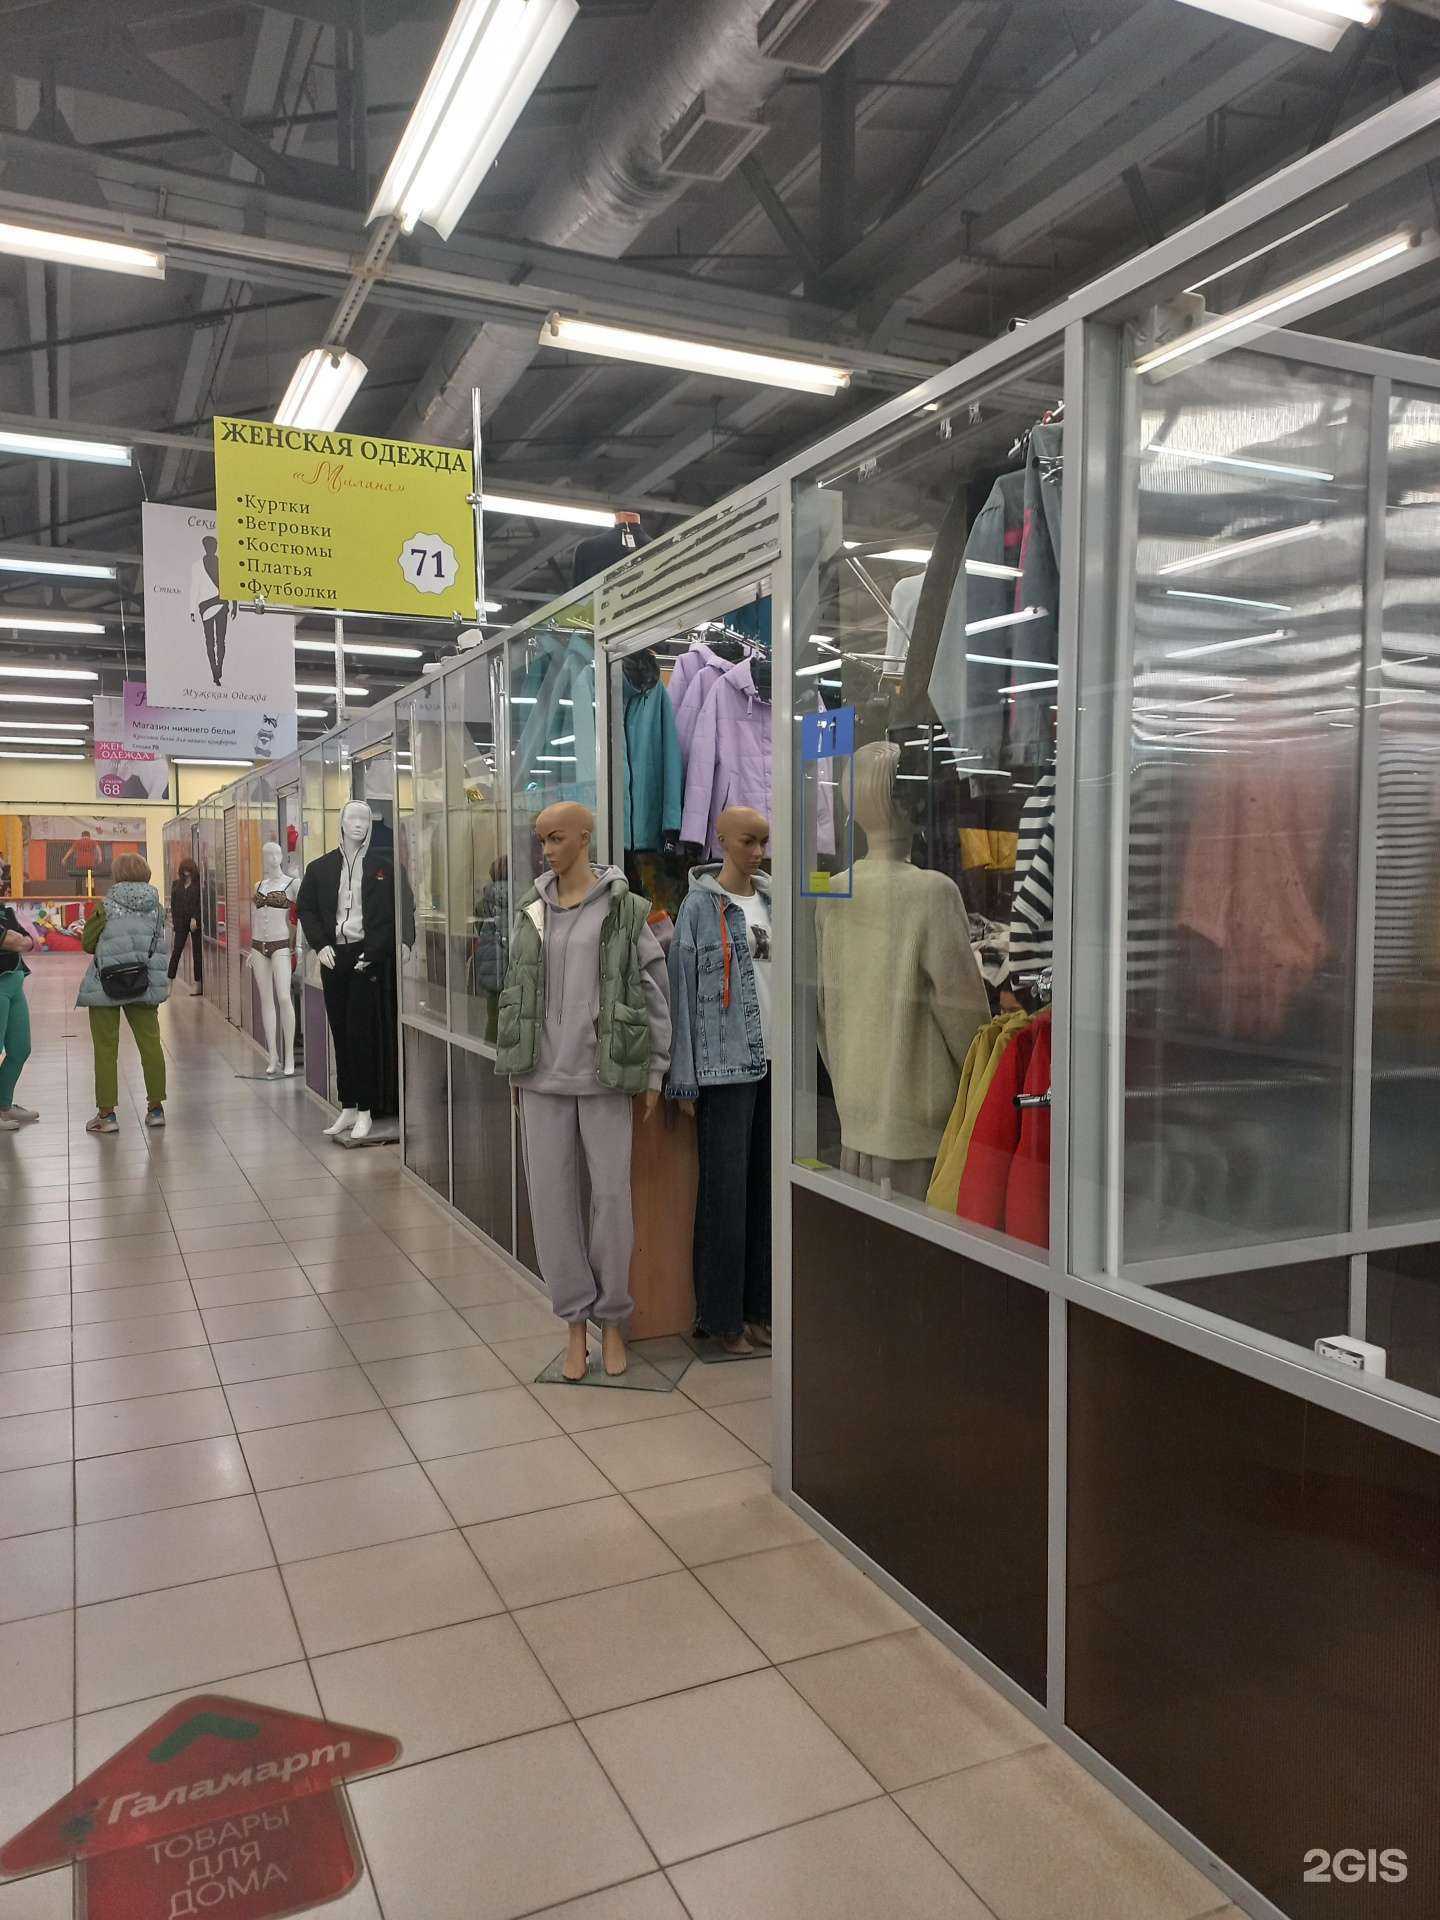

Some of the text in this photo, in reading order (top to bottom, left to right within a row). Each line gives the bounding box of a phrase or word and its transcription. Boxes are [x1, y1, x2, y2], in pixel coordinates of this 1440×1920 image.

[221, 421, 467, 474] ЖЕНСКАЯ ОДЕЖДА
[245, 494, 310, 514] Куртки
[245, 516, 332, 538] Ветровки
[246, 537, 333, 558] Костюмы
[247, 558, 312, 577] Платья
[410, 548, 445, 578] 71
[153, 583, 182, 594] Стиль
[247, 578, 338, 600] Футболки
[182, 687, 266, 702] Мужская Одежда
[132, 720, 236, 736] Магазин нижнего белья
[101, 750, 151, 760] ОДЕЖДА
[103, 783, 120, 795] 68
[107, 1741, 351, 1825] Галамарт
[146, 1807, 290, 1865] ТОВАРЫ
[186, 1841, 262, 1884] ДЛЯ
[168, 1862, 289, 1920] ДОМА
